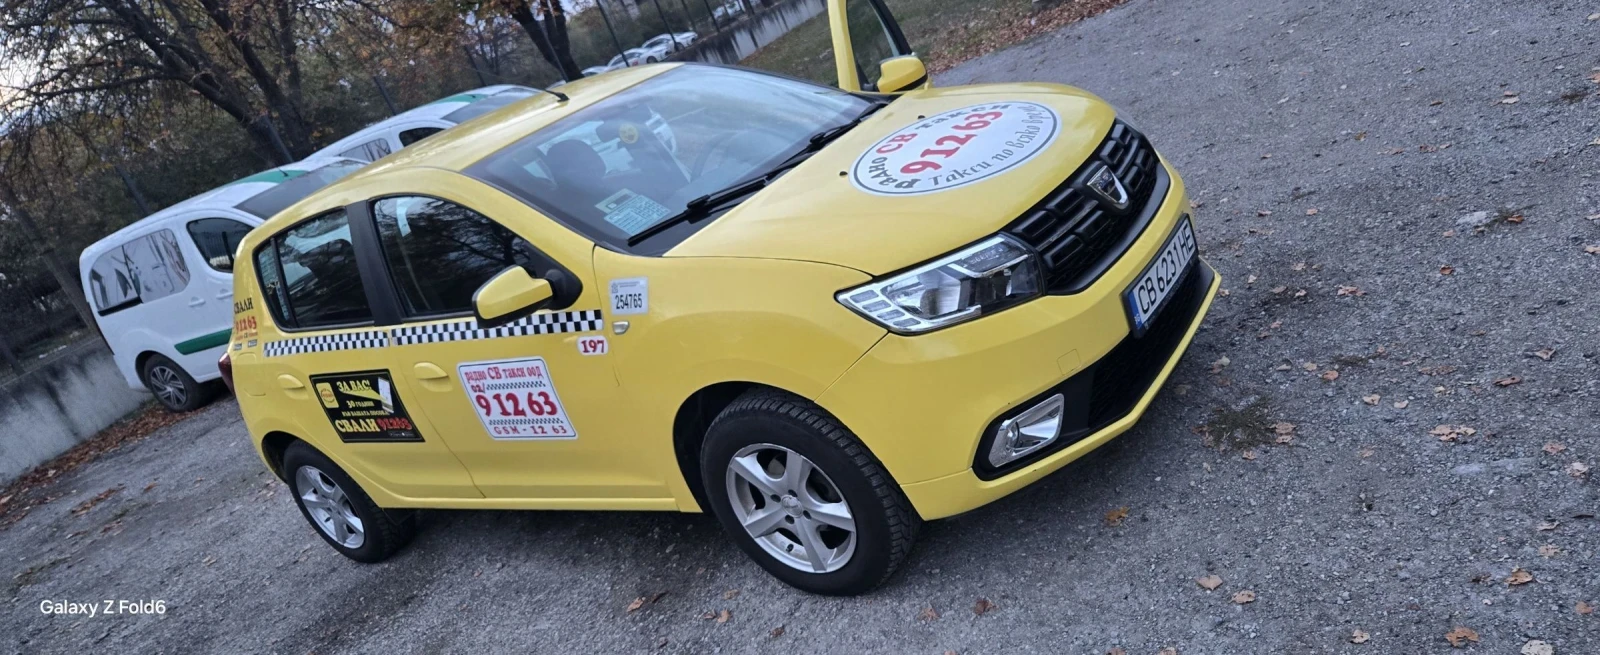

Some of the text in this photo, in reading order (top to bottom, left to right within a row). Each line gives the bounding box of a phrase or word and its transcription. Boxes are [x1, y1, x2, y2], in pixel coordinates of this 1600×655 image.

[876, 132, 918, 154] СВ
[928, 161, 991, 186] Такси
[992, 148, 1014, 162] по
[1004, 125, 1040, 149] всяко
[1155, 241, 1182, 294] 6231
[615, 293, 643, 310] 254765
[581, 339, 605, 354] 197
[487, 366, 502, 380] СВ
[502, 367, 526, 380] такси
[336, 379, 372, 392] ЗА ВАС!
[335, 418, 381, 433] СВАЛИ
[494, 425, 521, 435] GSM
